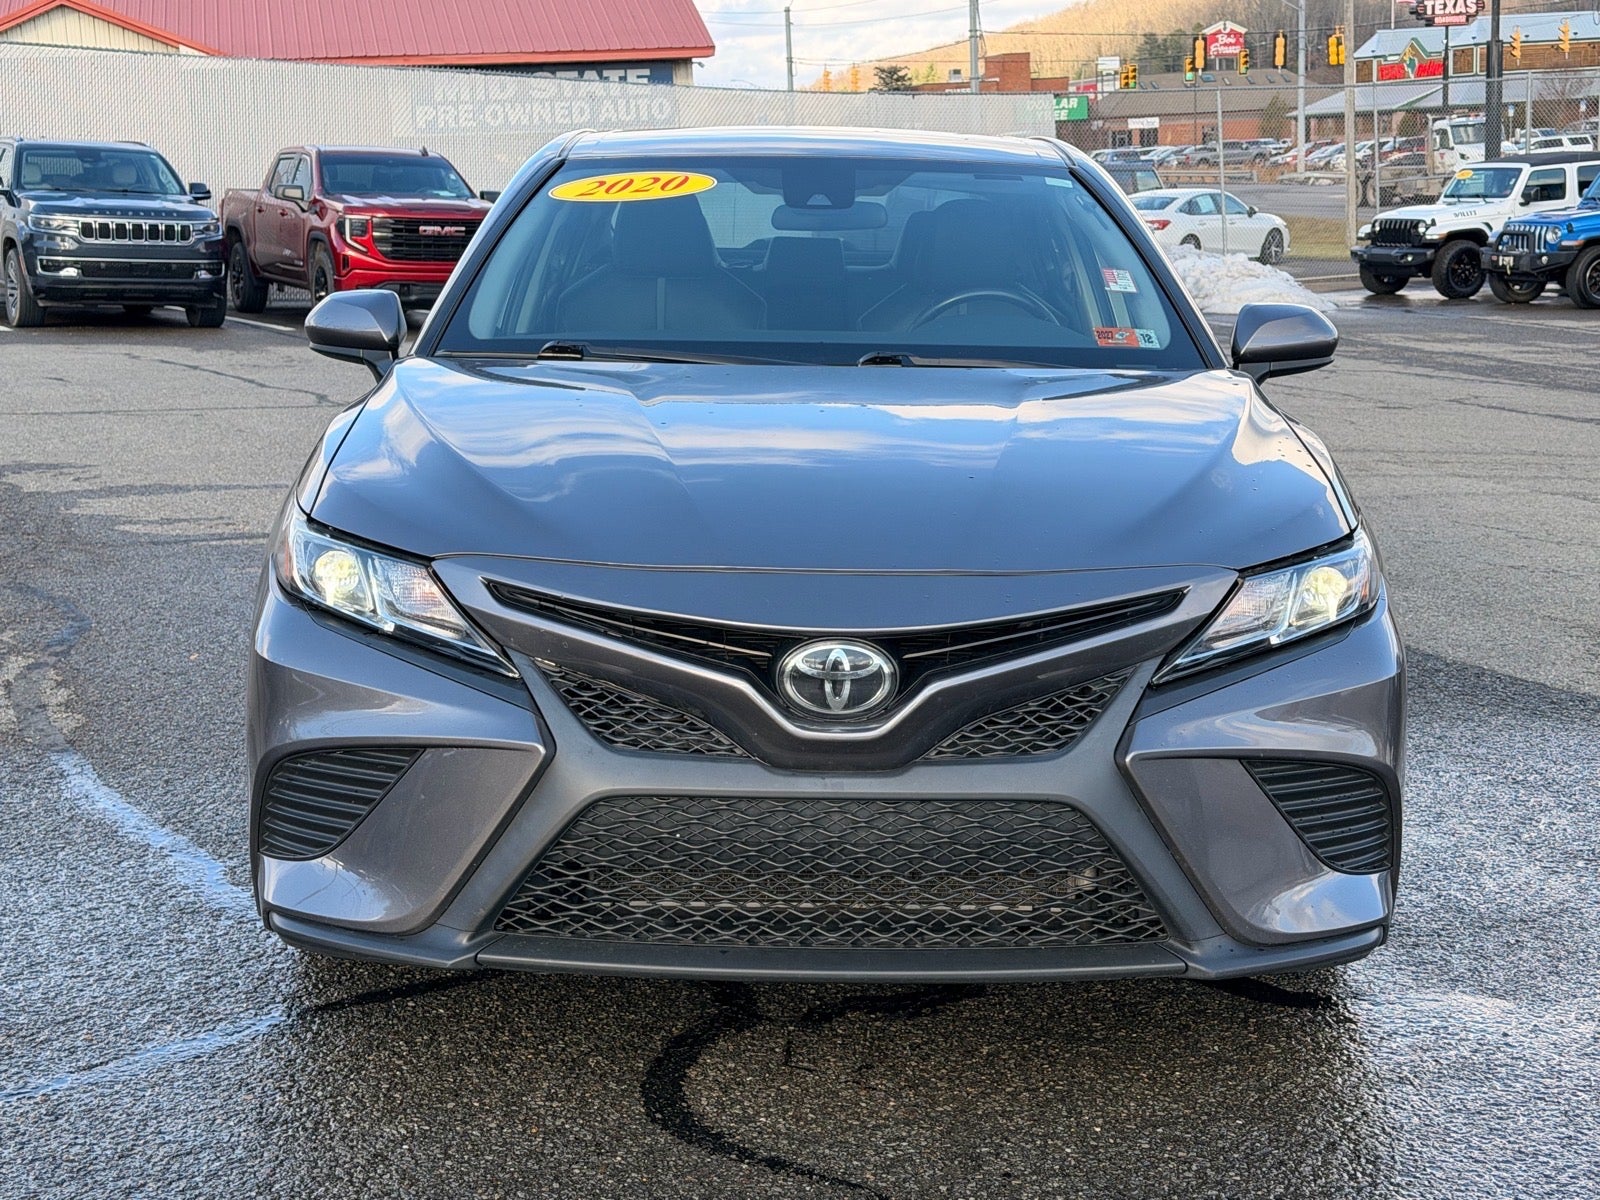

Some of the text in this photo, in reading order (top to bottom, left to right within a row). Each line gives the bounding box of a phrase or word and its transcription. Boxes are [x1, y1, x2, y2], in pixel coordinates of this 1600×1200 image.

[1424, 0, 1477, 15] TEXAS
[600, 98, 671, 123] AUTO
[574, 175, 690, 197] 2020
[418, 225, 466, 236] GMC
[1096, 330, 1154, 344] 2027 12
